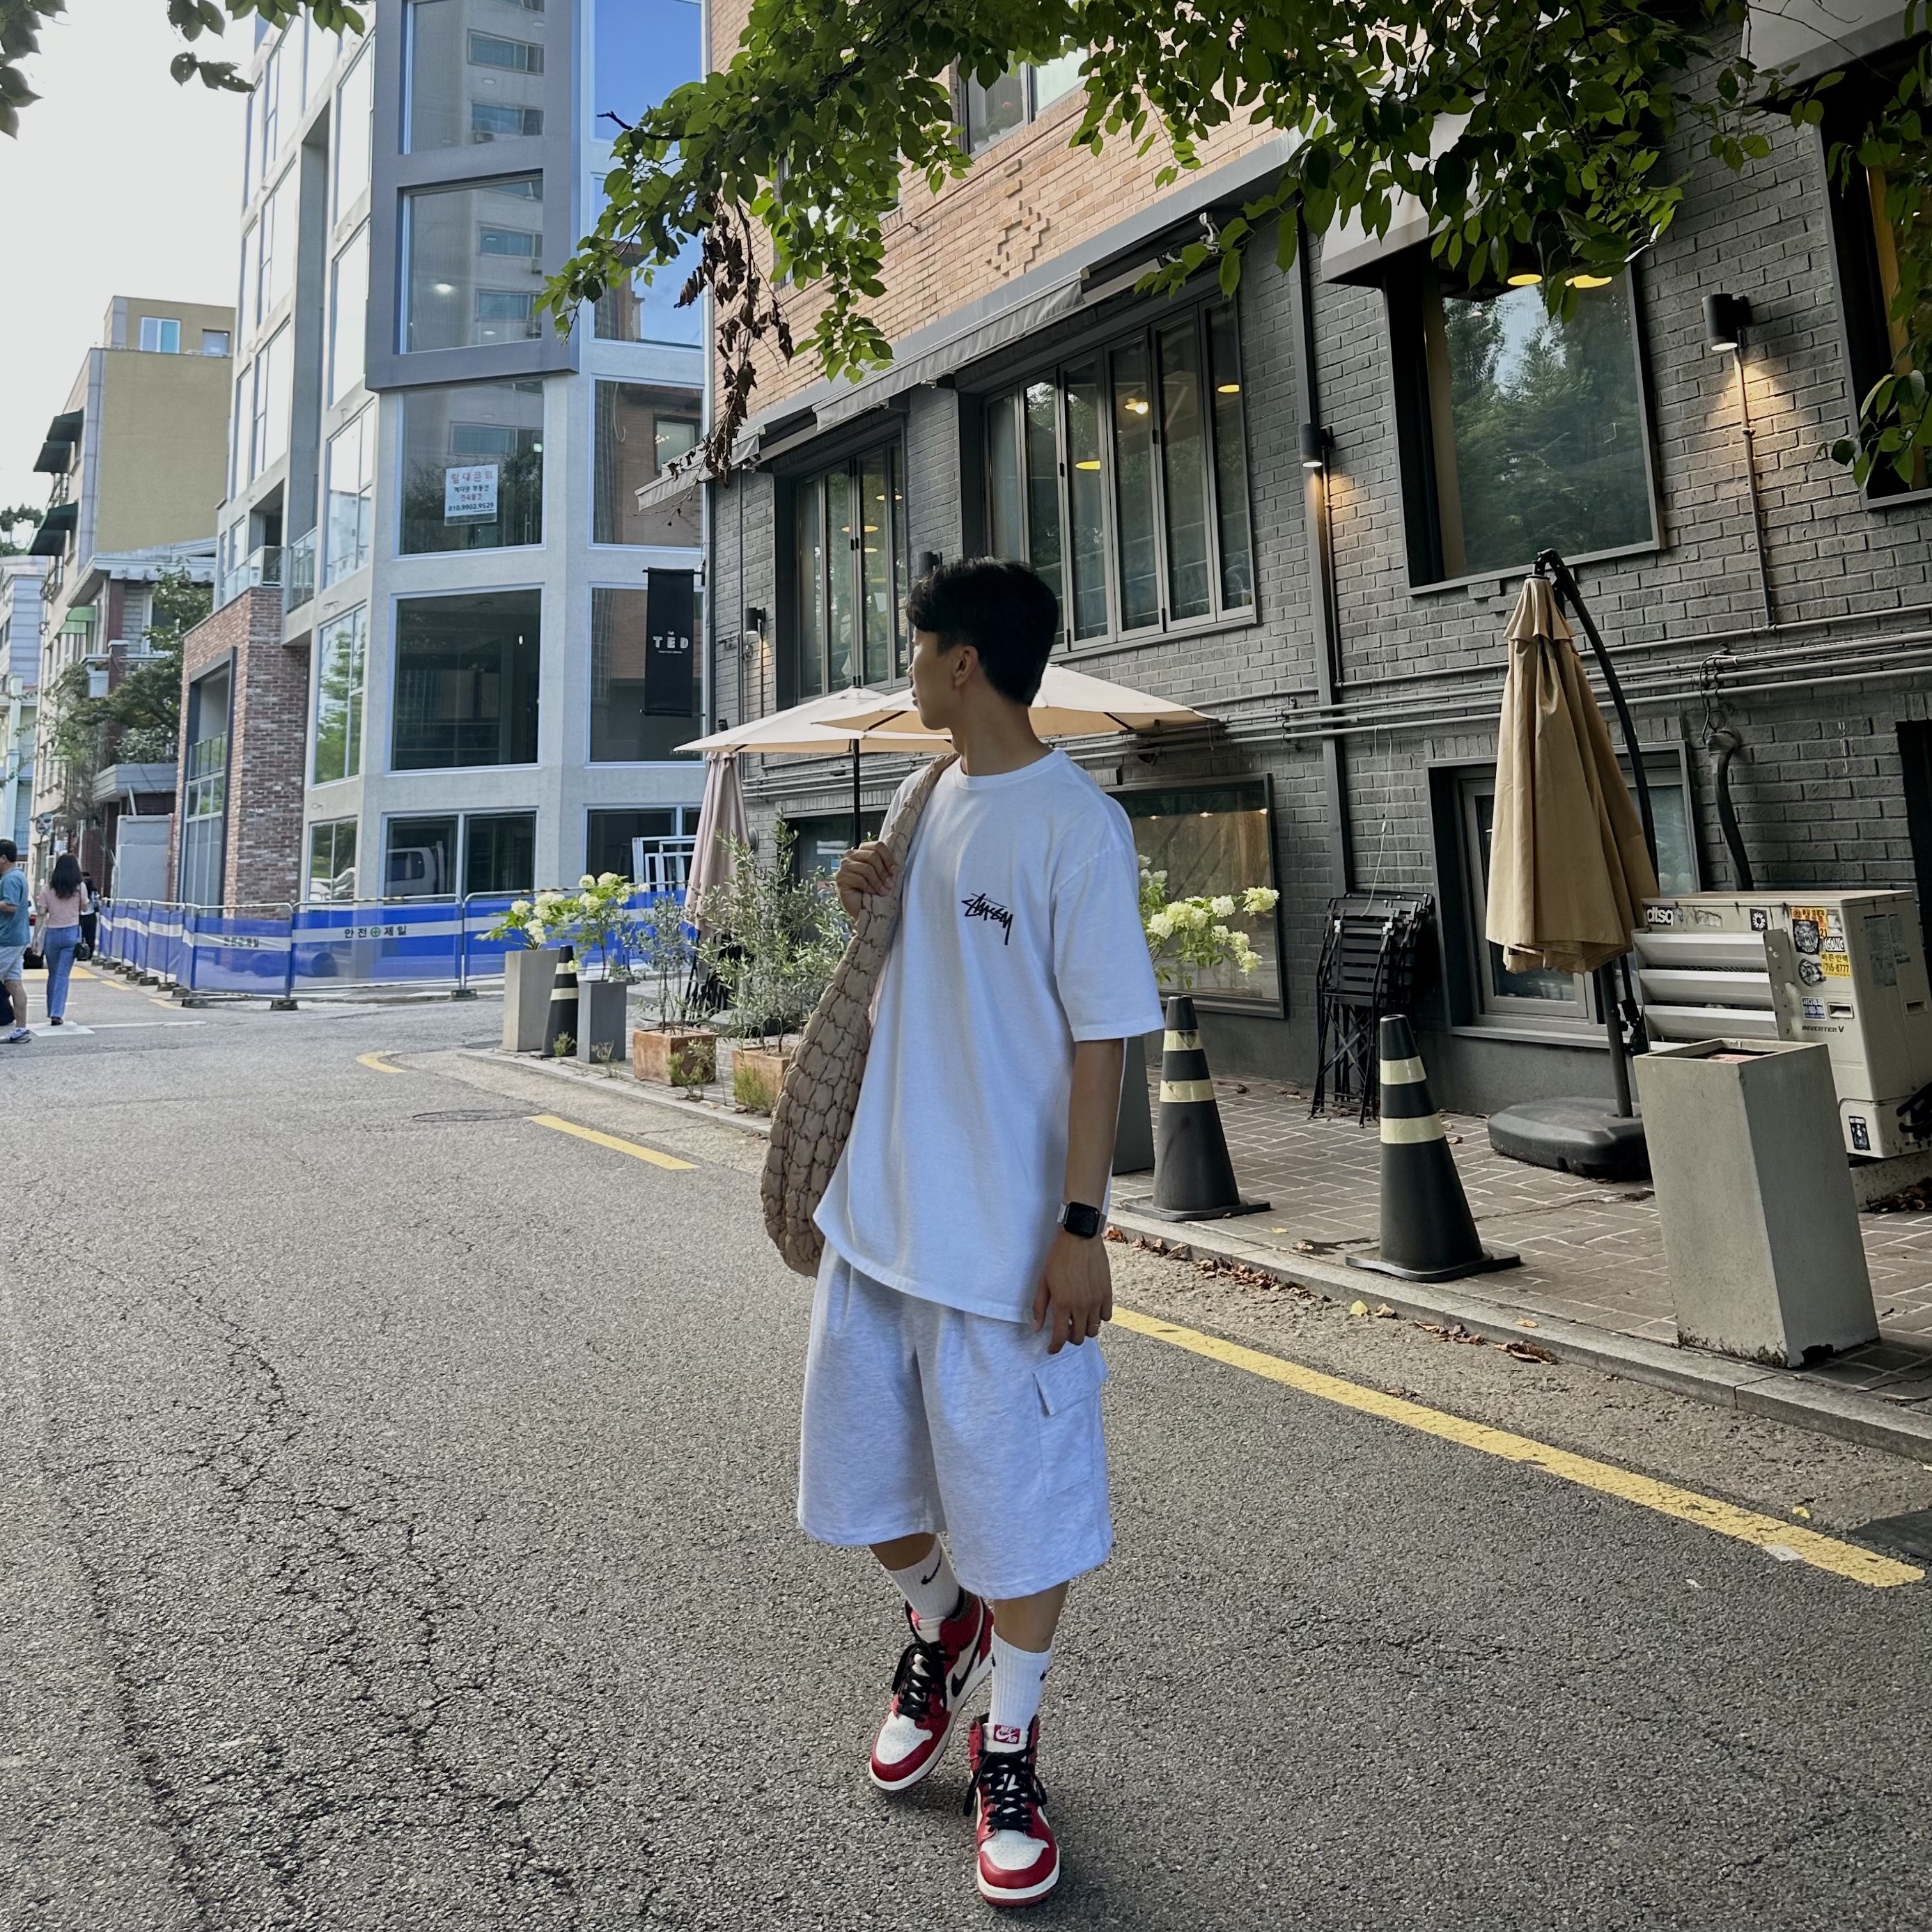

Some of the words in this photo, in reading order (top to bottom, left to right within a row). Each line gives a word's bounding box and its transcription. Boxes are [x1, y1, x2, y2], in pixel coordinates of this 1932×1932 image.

[448, 502, 494, 512] 010.9902.9529
[653, 636, 689, 648] TED
[1646, 906, 1674, 926] dtsq
[345, 928, 368, 938] 안전
[384, 926, 407, 936] 제일
[1825, 937, 1844, 951] GONG
